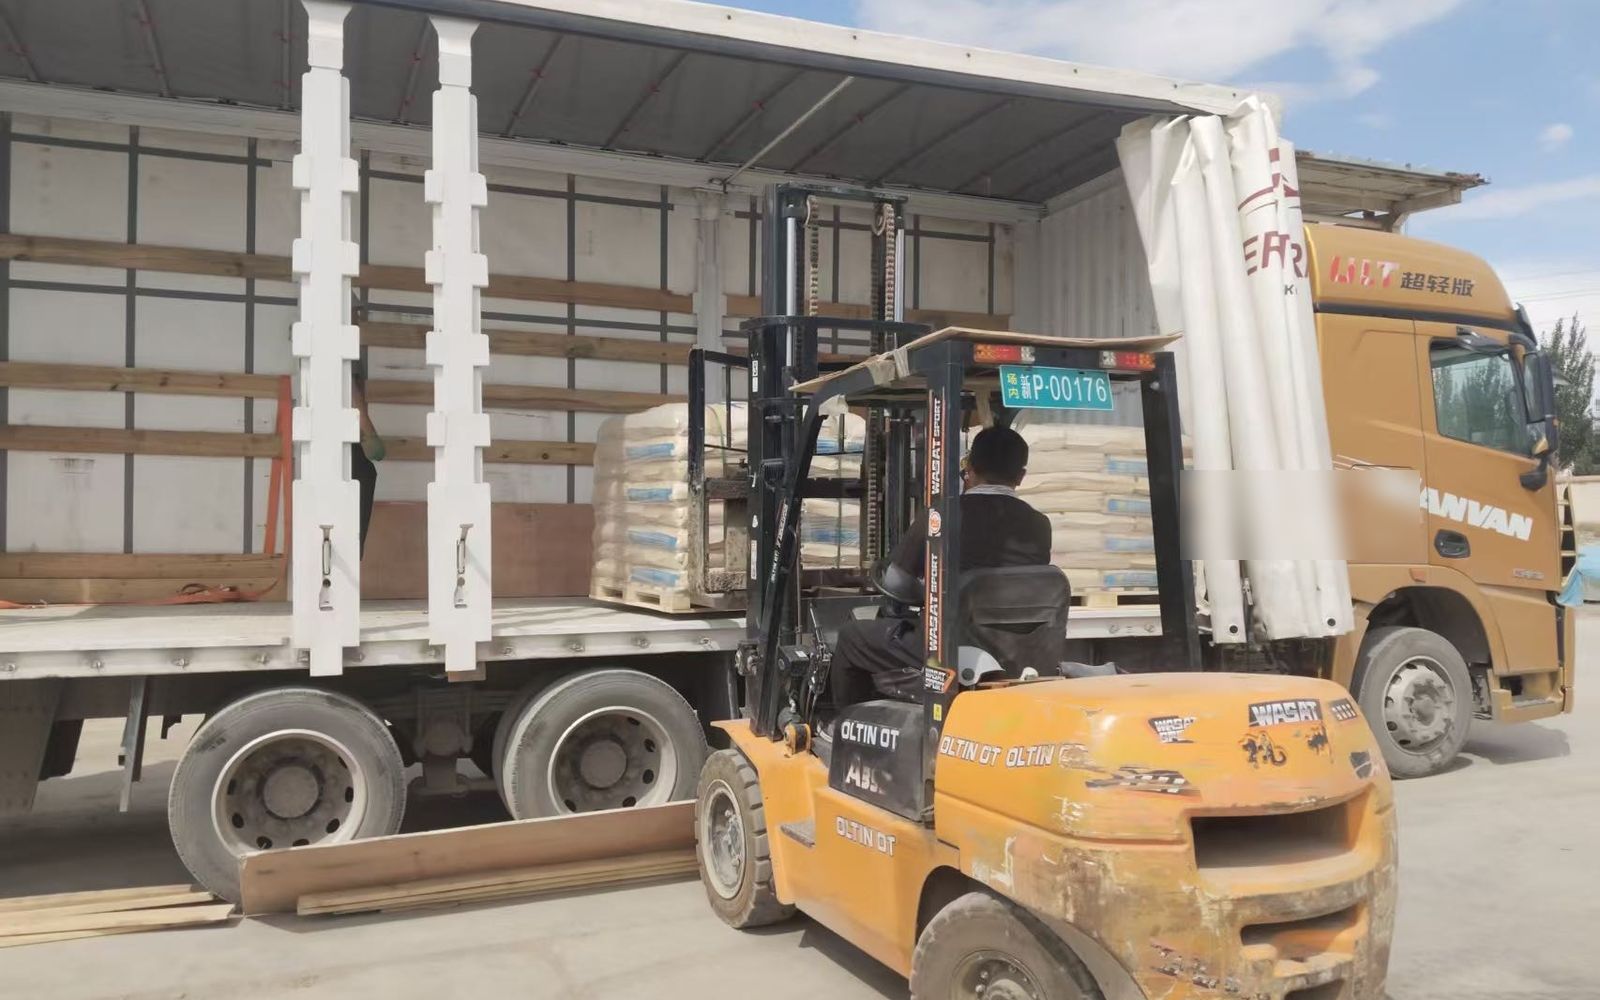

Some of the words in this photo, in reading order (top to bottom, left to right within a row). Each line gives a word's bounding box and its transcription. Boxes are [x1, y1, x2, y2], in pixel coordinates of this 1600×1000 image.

[1400, 271, 1475, 298] 超轻版
[933, 397, 941, 437] SPORT
[931, 438, 941, 495] WASAT
[1419, 485, 1533, 541] ANVAN
[929, 593, 938, 651] WASAT
[1251, 700, 1317, 727] WASAT
[841, 720, 877, 746] OLTIN
[880, 726, 900, 750] OT
[940, 736, 976, 762] OLTIN
[979, 746, 1002, 766] OT
[1005, 744, 1055, 767] OLTIN
[836, 816, 873, 848] OLTIN
[876, 832, 896, 856] OT
